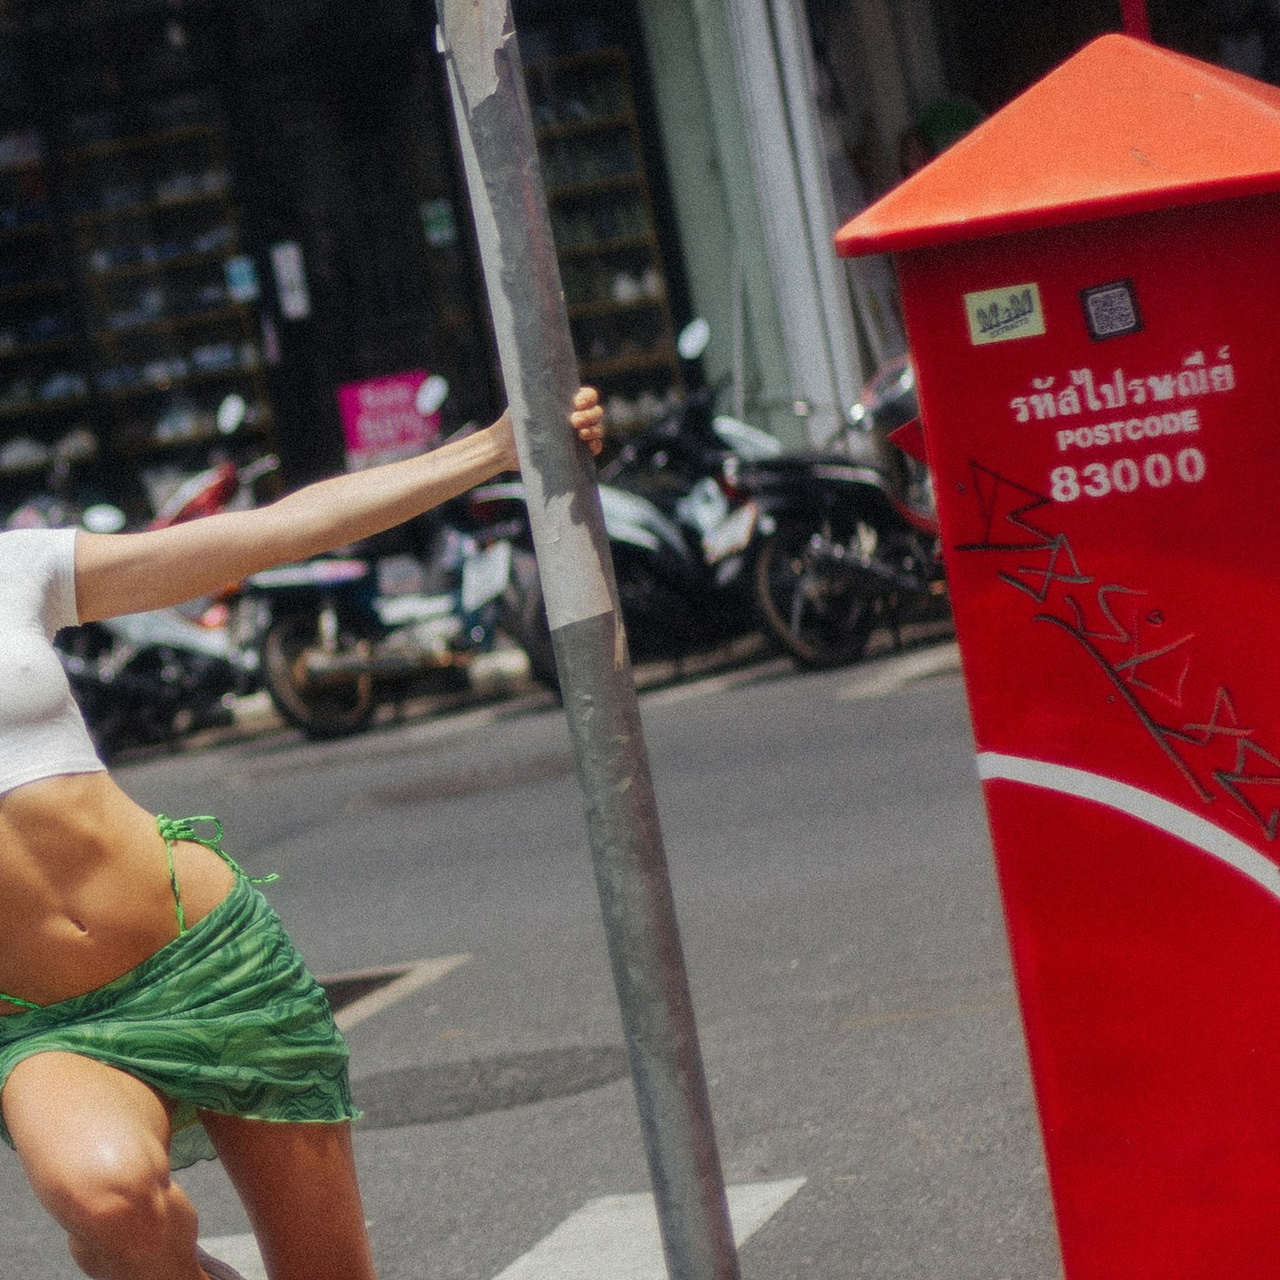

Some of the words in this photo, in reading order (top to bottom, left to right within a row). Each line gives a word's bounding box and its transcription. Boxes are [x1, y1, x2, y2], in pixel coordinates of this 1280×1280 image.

[1009, 345, 1235, 422] รหัสไปรษณีย์
[1055, 409, 1201, 451] POSTCODE
[1049, 446, 1208, 503] 83000
